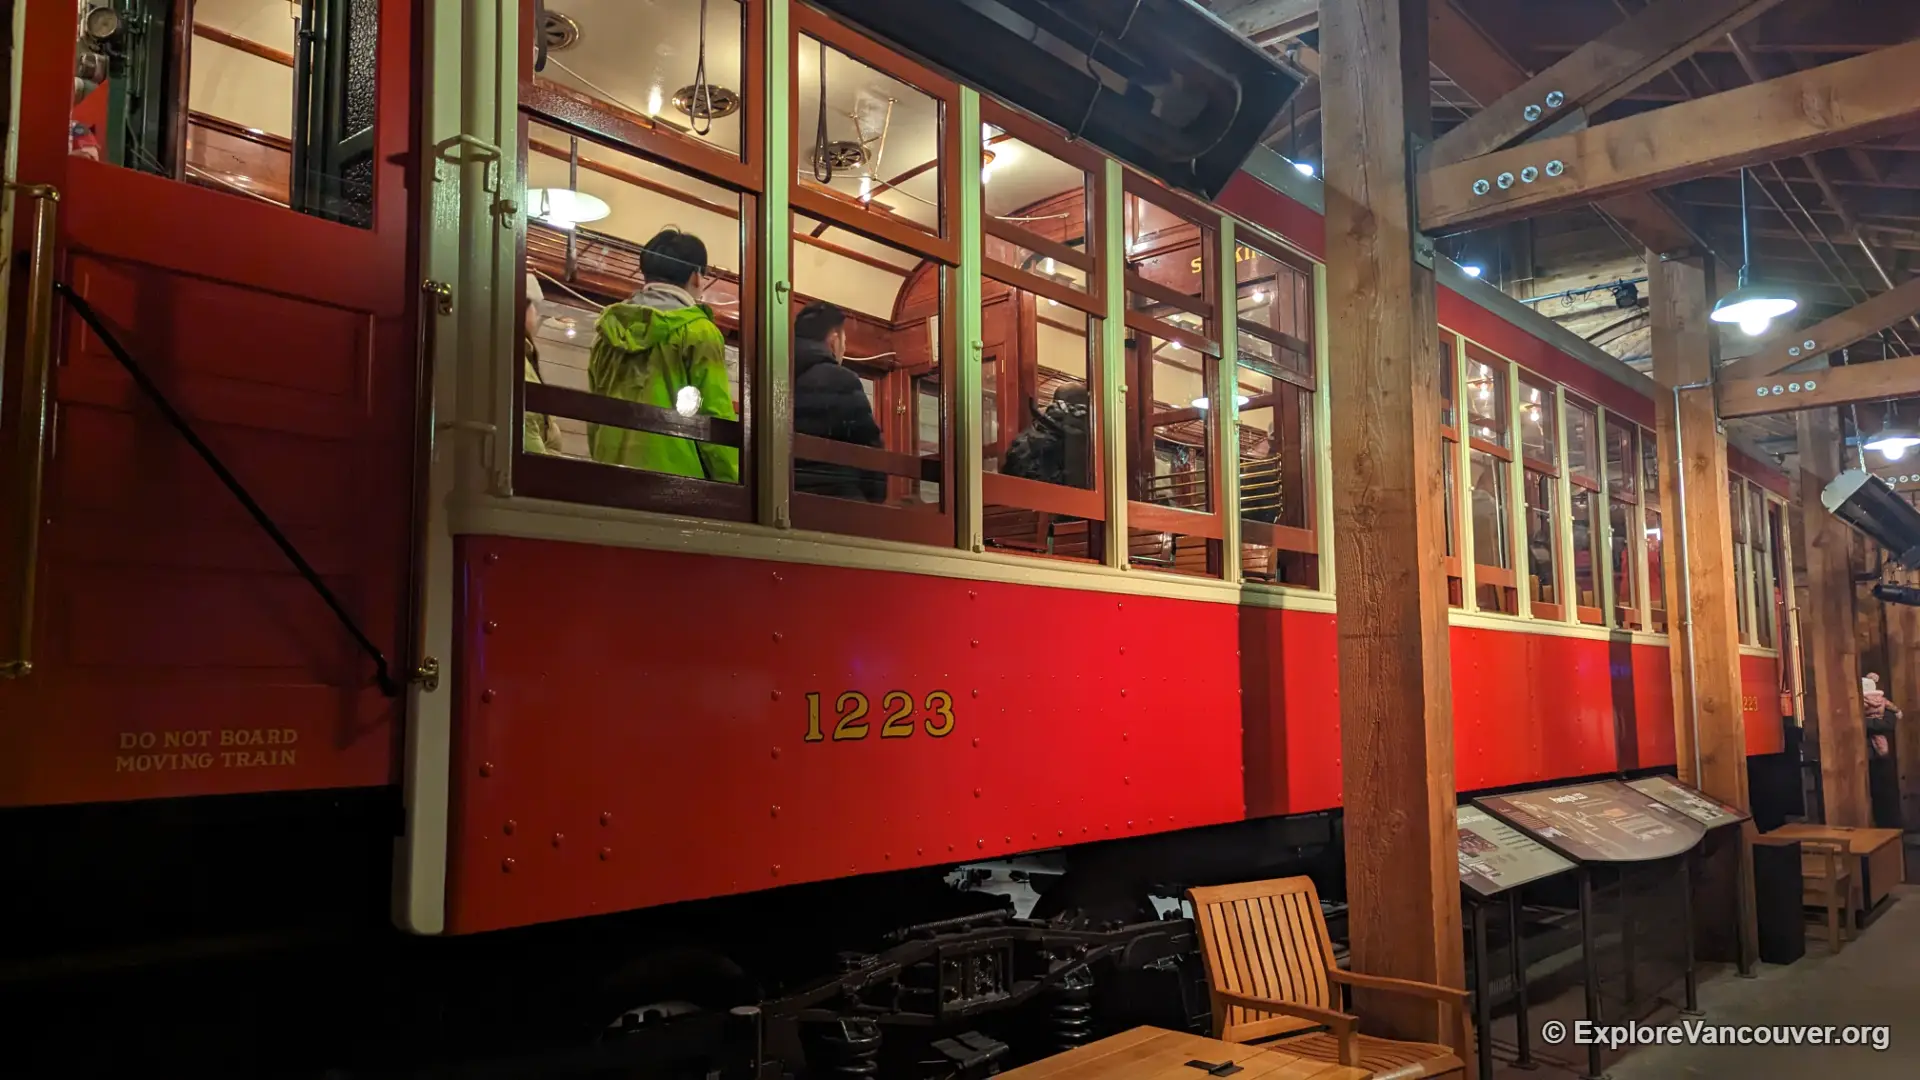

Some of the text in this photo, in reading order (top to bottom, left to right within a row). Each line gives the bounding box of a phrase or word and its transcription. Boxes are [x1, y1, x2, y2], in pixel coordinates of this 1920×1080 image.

[1743, 696, 1758, 711] 223
[804, 690, 955, 742] 1223
[120, 728, 298, 749] DO NOT BOARD
[115, 749, 297, 772] MOVING TRAIN
